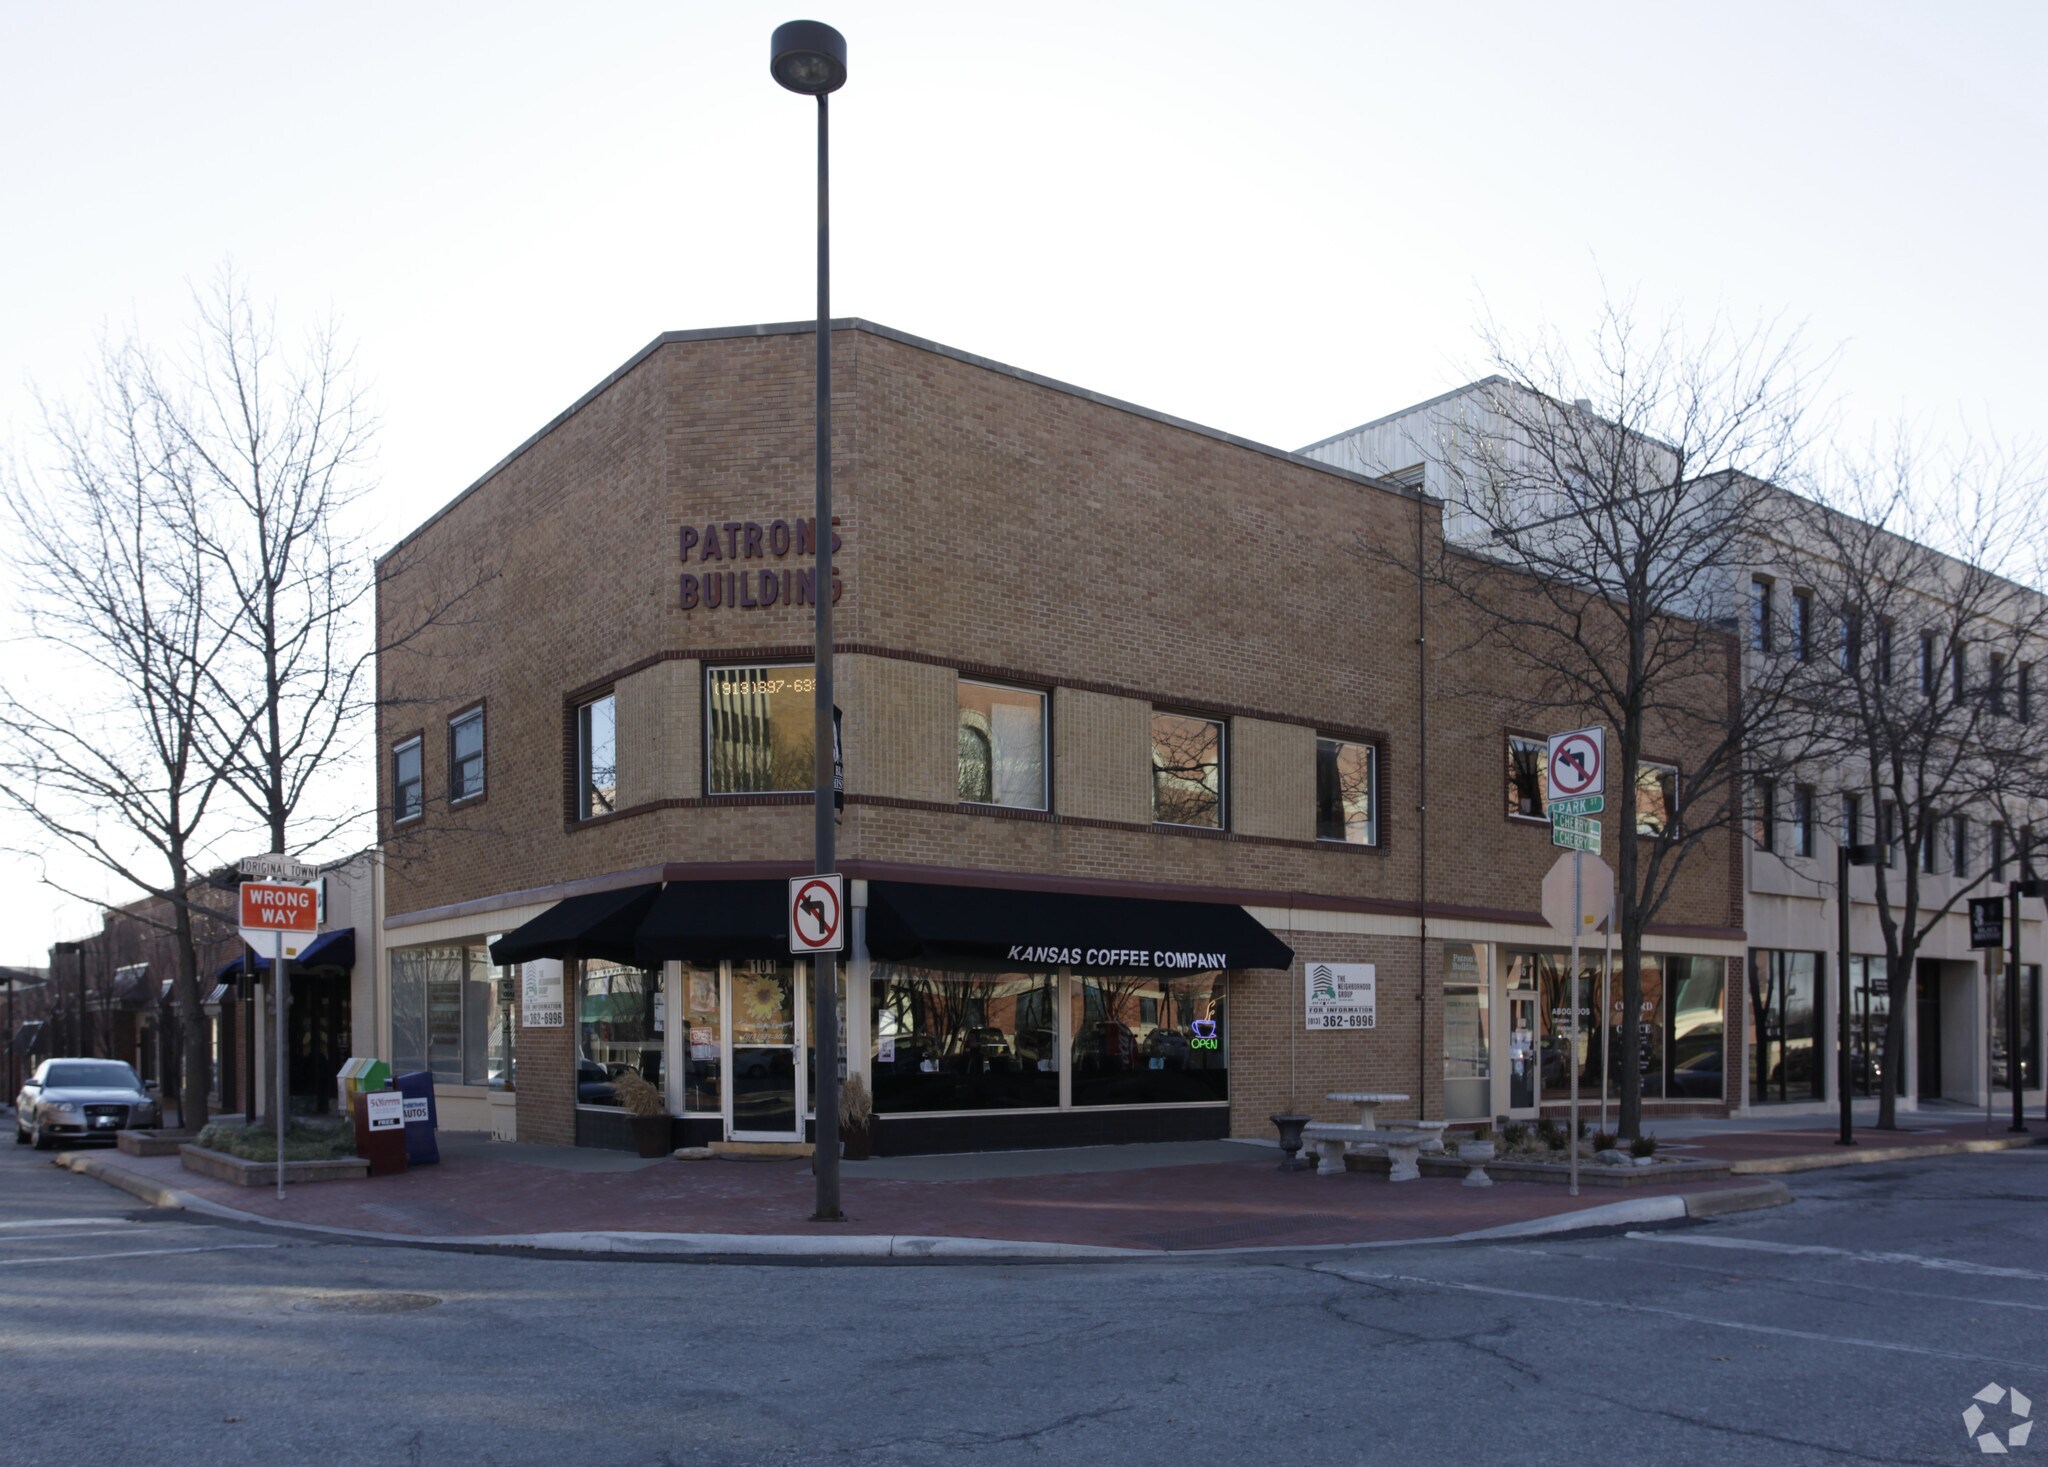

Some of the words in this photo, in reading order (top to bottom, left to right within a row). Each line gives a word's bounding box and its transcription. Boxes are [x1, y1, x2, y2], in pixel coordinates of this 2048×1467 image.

[1559, 799, 1586, 814] PARK
[1560, 814, 1588, 834] CHERRY
[1560, 831, 1588, 849] CHERRY
[246, 860, 287, 876] ORIGINAL
[292, 865, 314, 879] TOWN
[250, 889, 309, 908] WRONG
[261, 908, 297, 925] WAY
[1007, 945, 1082, 965] KANSAS
[1086, 948, 1150, 967] COFFEE
[1153, 950, 1227, 969] COMPANY
[752, 960, 775, 973] 101
[530, 1012, 563, 1025] 362-6996
[1551, 1007, 1591, 1016] ABOGDOS
[1322, 1015, 1374, 1027] 362-6996
[1190, 1037, 1218, 1050] OPEN
